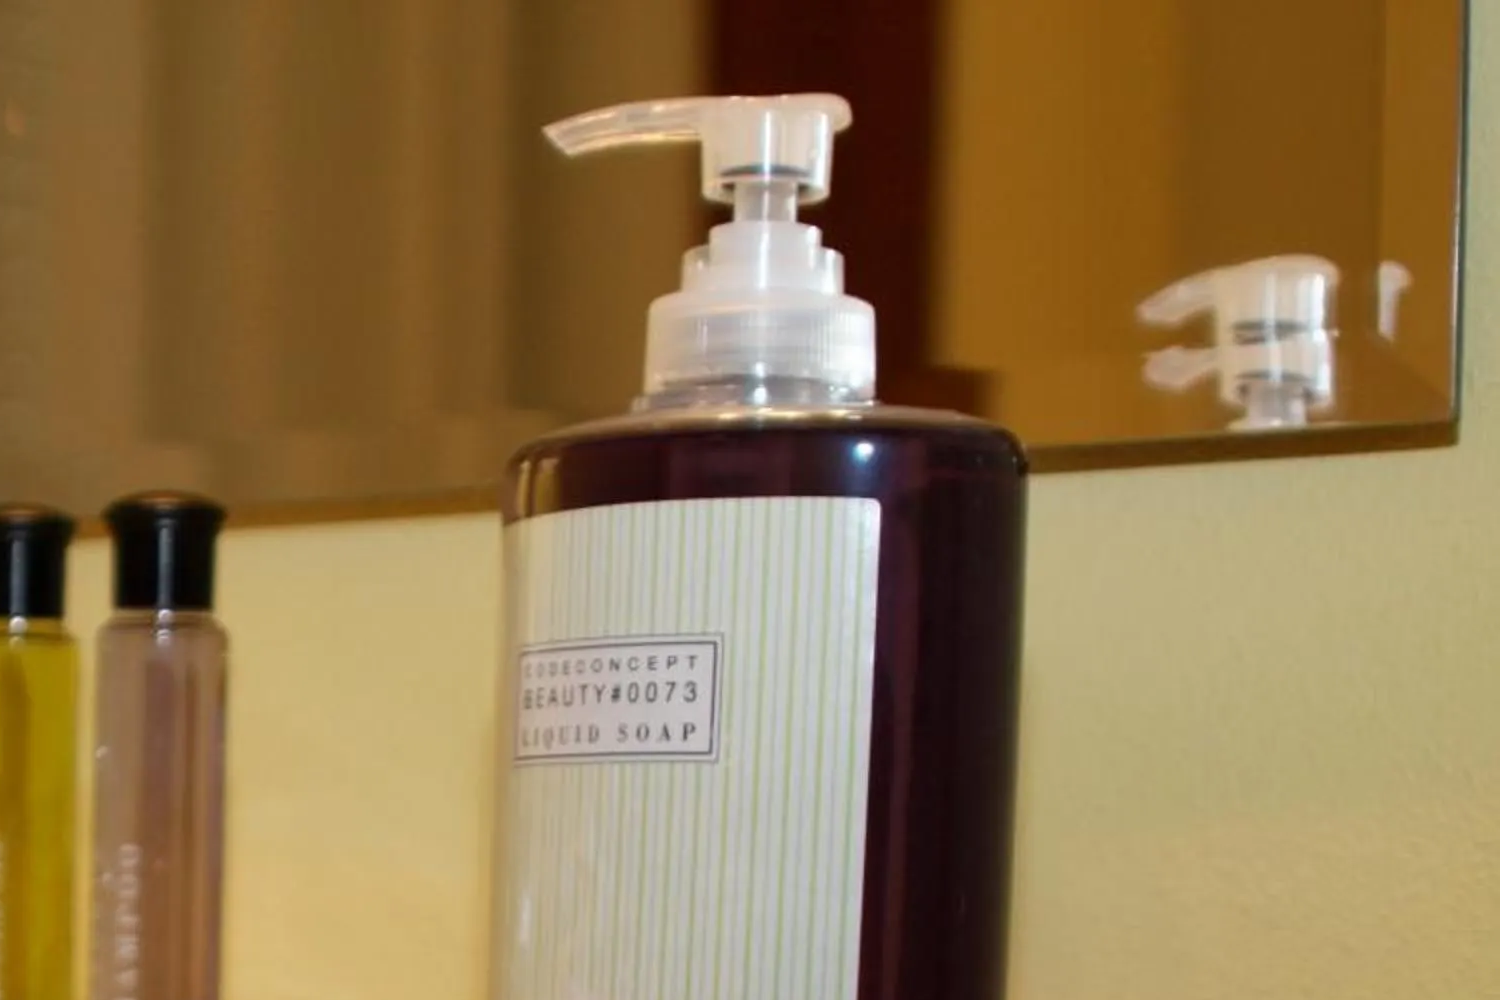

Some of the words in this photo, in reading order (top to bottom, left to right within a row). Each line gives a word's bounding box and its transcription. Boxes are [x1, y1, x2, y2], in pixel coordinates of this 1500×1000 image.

[524, 655, 699, 678] CODECONCEPT
[523, 681, 698, 710] BEAUTY#0073
[521, 725, 600, 748] LIQUID
[616, 721, 697, 743] SOAP
